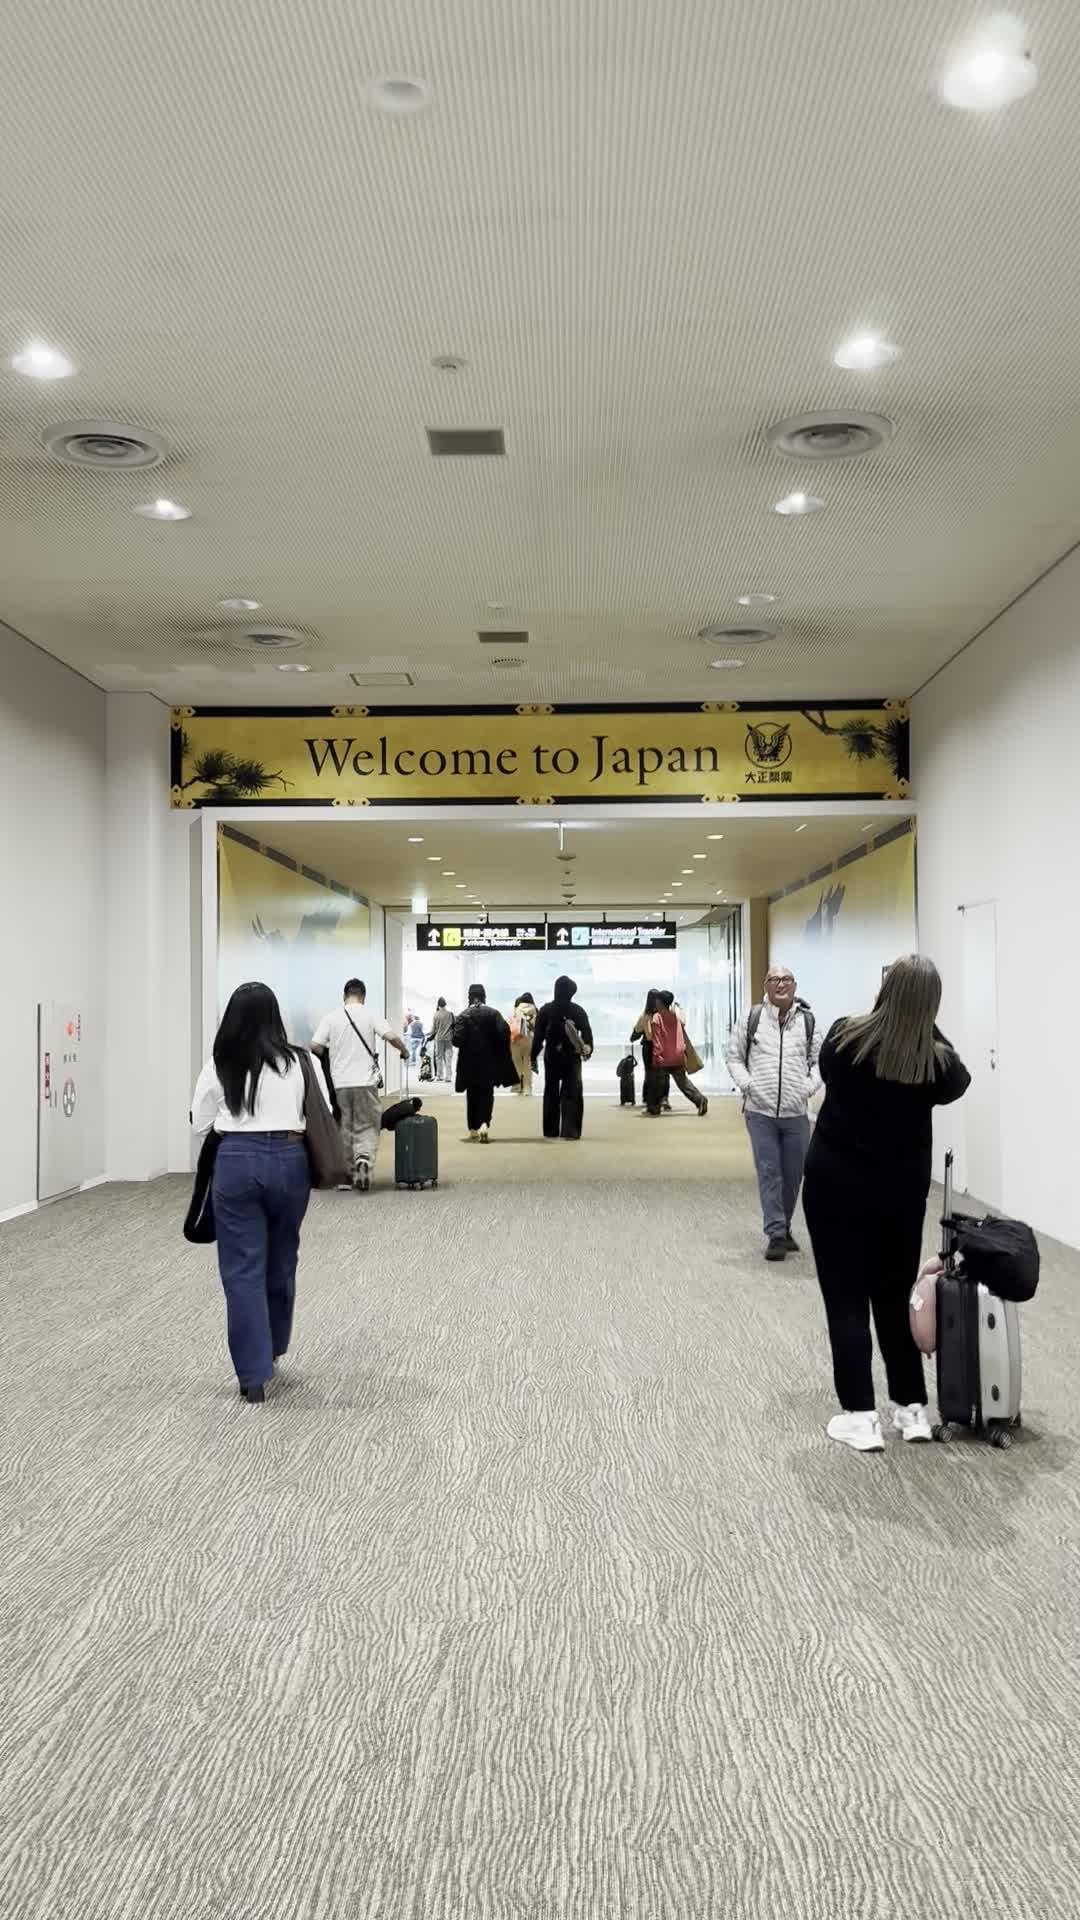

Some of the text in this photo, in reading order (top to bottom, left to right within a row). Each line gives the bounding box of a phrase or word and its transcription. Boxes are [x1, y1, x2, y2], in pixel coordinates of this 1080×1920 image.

[304, 735, 720, 785] Welcome to Japan
[591, 927, 637, 936] International
